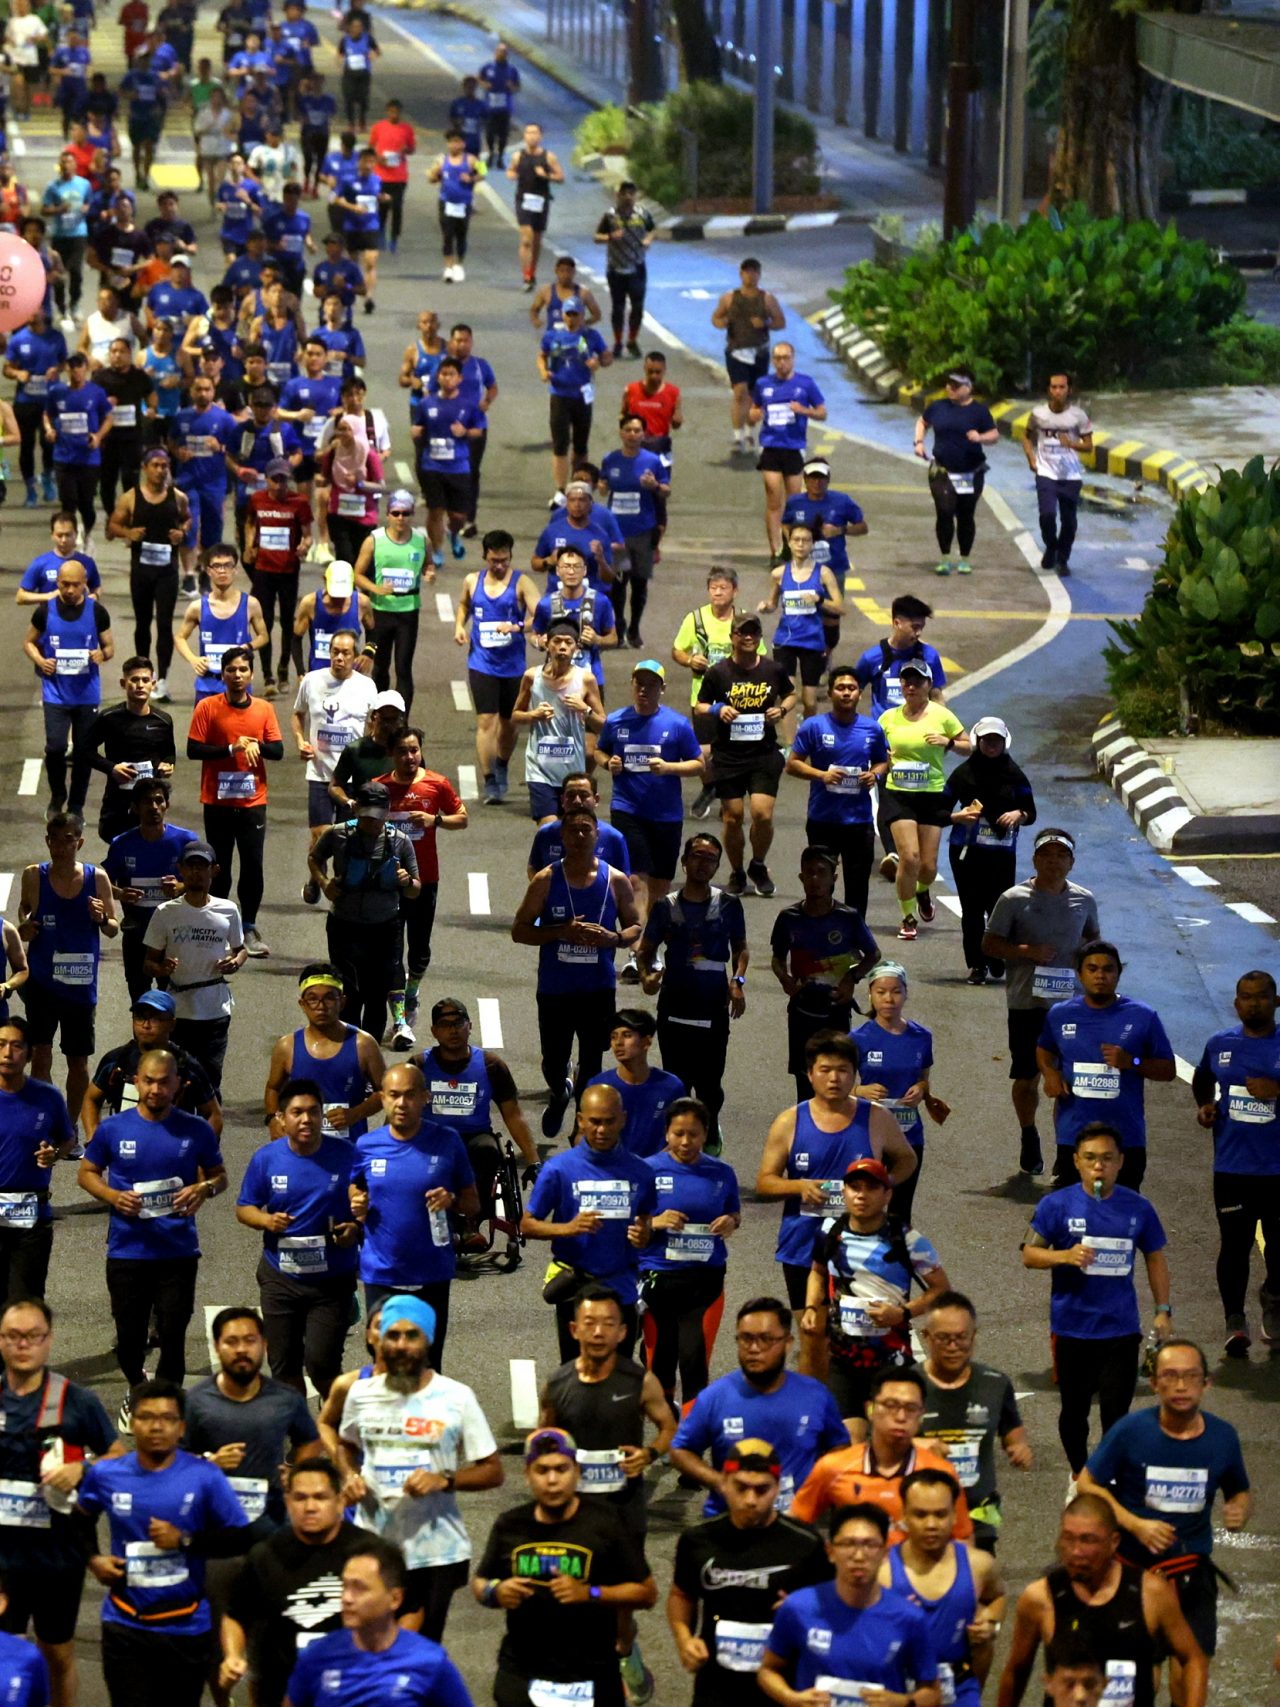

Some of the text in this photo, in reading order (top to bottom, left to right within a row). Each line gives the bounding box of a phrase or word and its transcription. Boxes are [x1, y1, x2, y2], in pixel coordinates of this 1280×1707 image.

[1074, 1076, 1119, 1088] AM-02889
[1095, 1252, 1127, 1263] -00200
[518, 1554, 582, 1577] NATURA
